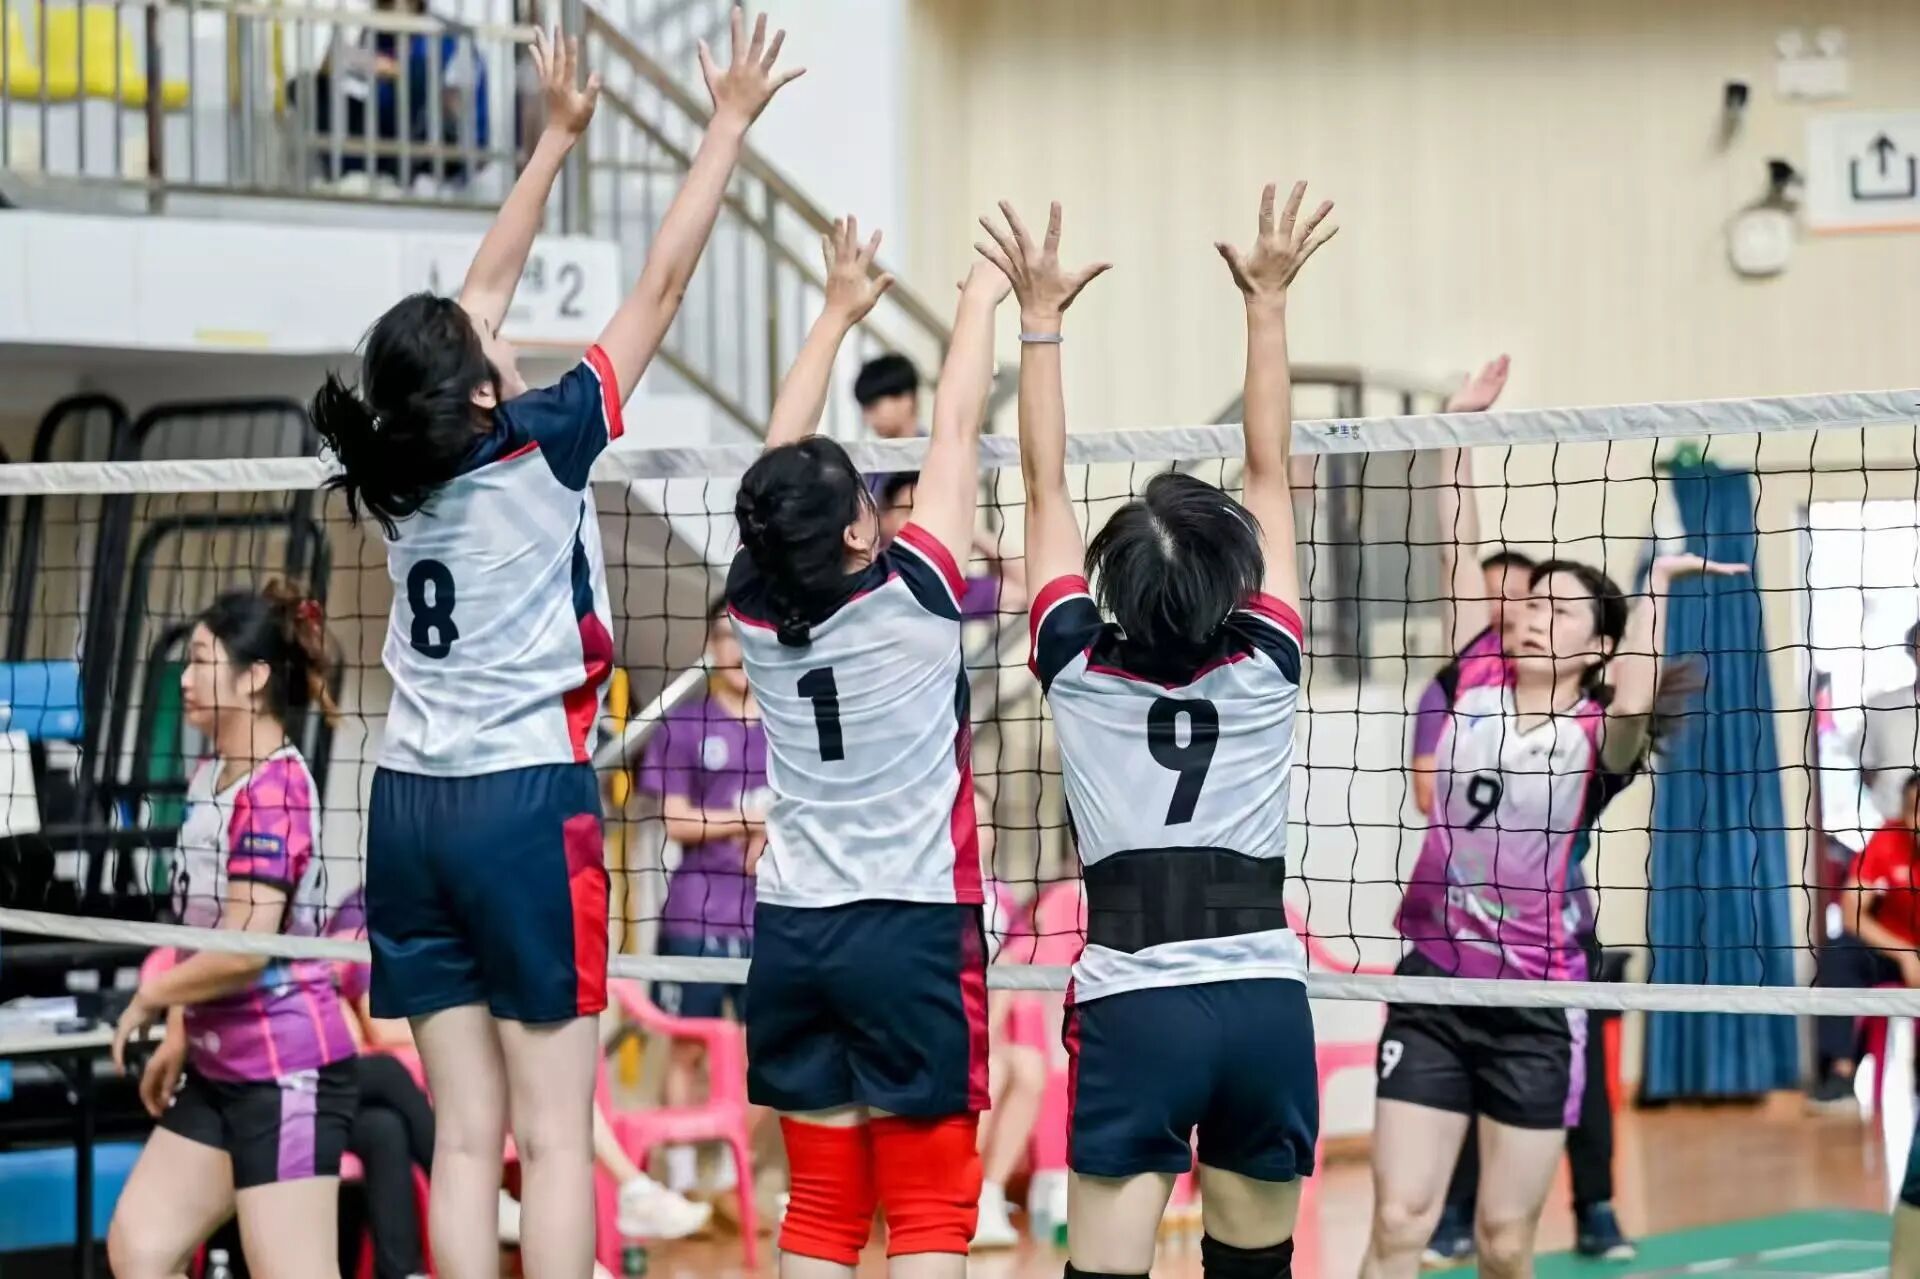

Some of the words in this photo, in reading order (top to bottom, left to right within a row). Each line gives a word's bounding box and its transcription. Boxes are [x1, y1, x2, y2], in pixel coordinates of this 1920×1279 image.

[557, 262, 585, 317] 2
[407, 559, 460, 659] 8
[797, 666, 844, 761] 1
[1147, 697, 1219, 826] 9
[1466, 774, 1500, 832] 9
[1381, 1039, 1404, 1079] 9
